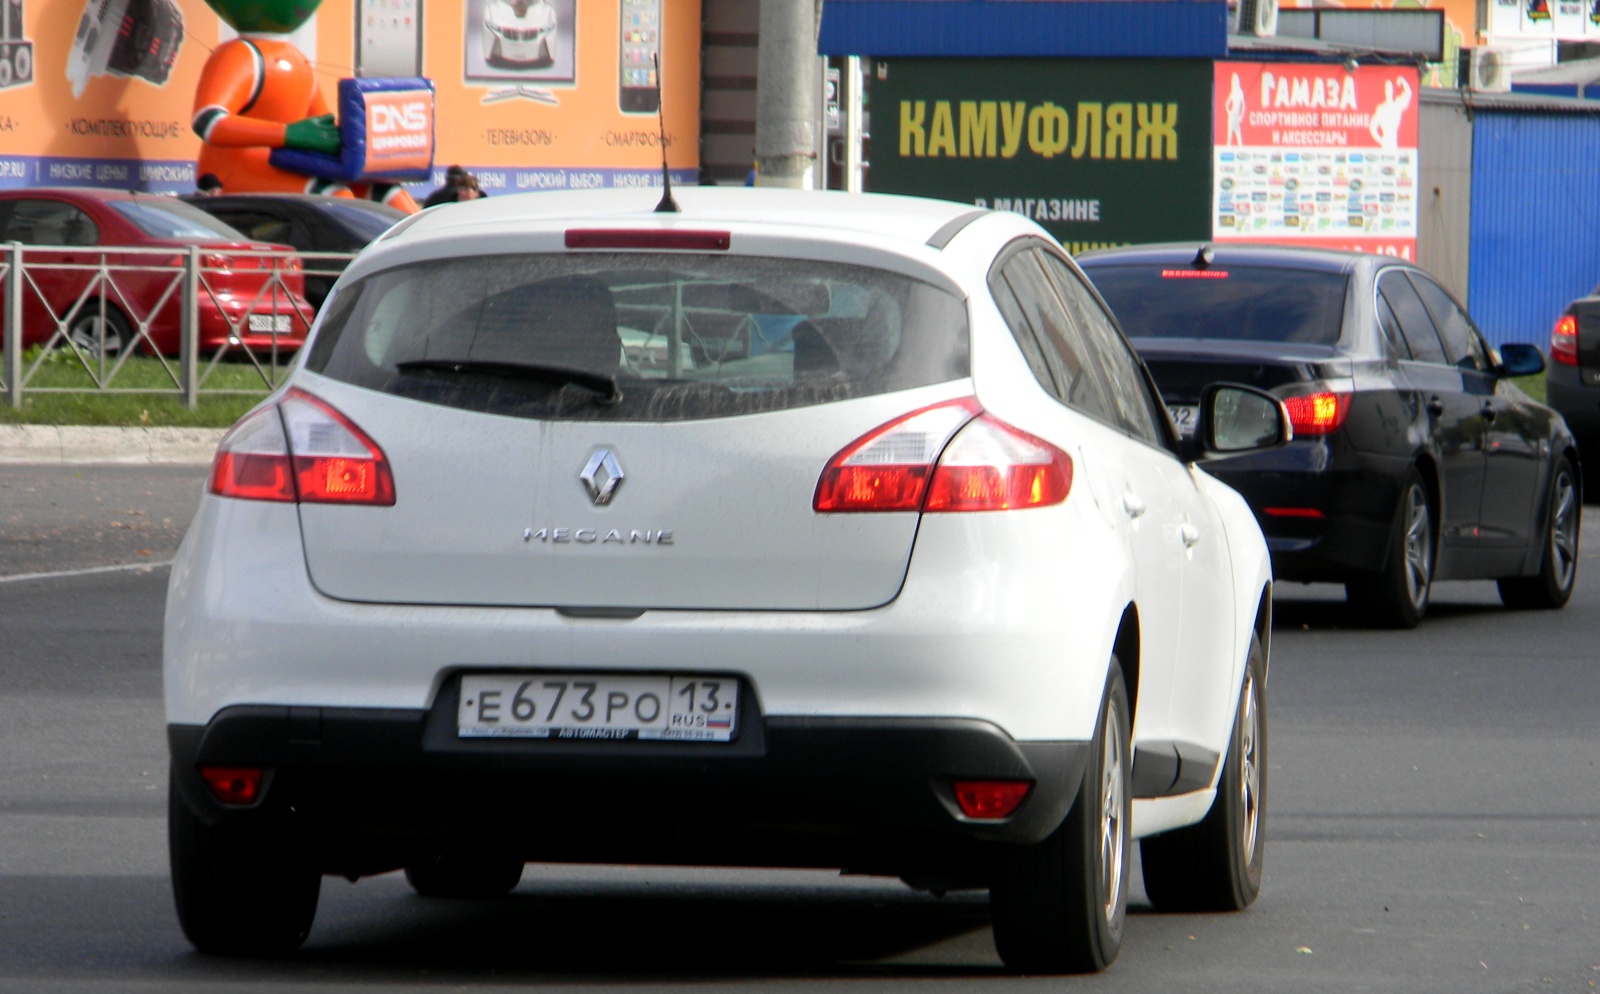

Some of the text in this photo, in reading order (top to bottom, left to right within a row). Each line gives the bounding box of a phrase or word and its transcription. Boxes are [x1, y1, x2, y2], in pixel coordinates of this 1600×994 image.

[1261, 71, 1358, 110] ГАМАЗА
[371, 103, 427, 132] DNS
[1249, 111, 1371, 127] СПОРТИВНОЕ ПИТАНИЕ
[71, 118, 180, 138] КОМПЛЕКТУЮЩИЕ
[486, 129, 552, 146] ТЕЛЕВИЗОРЫ
[899, 101, 1178, 159] КАМУФЛЯЖ
[605, 130, 673, 147] СМАРТФОНЫ
[1272, 131, 1347, 145] И АКСЕССУАРЫ
[50, 163, 92, 179] НИЗКИЕ
[139, 164, 194, 182] ШИРОКИЙ
[516, 170, 566, 187] ШИРОКИЙ
[613, 173, 650, 187] НИЗКИЕ
[994, 198, 1100, 221] МАГАЗИНЕ
[523, 526, 675, 545] MEGANE
[678, 682, 721, 713] 13
[672, 714, 706, 728] RUS
